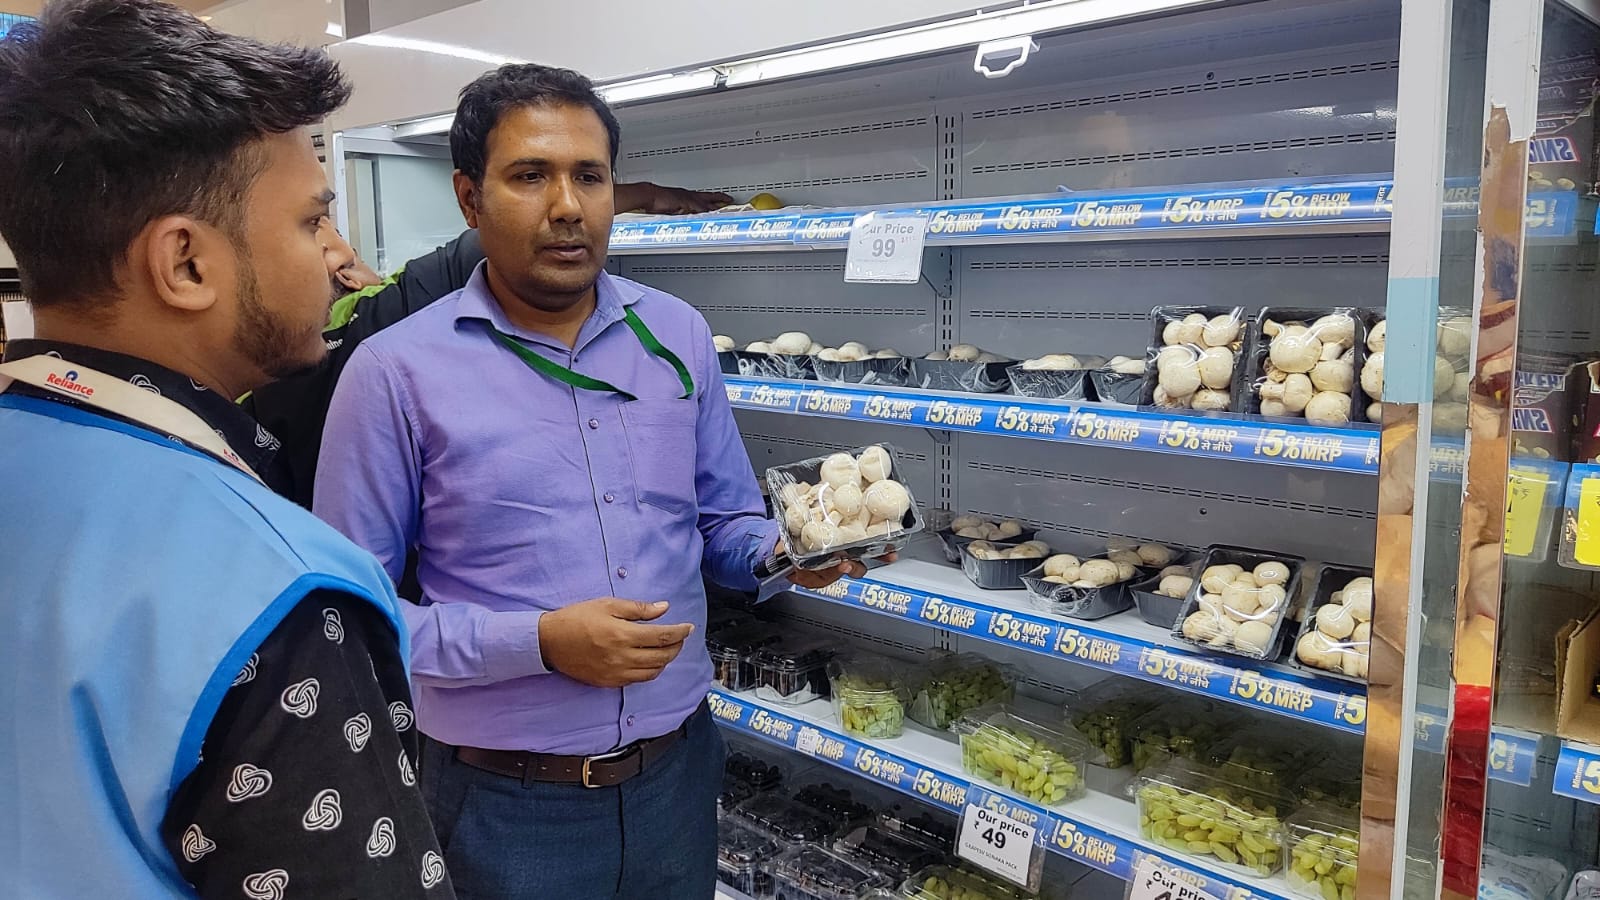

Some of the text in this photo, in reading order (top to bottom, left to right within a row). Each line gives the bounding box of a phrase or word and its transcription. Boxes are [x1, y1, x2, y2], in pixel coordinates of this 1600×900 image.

[1078, 201, 1111, 227] 5%
[1111, 203, 1143, 213] BELOW
[1169, 197, 1206, 223] 5%
[1205, 198, 1243, 210] MRP
[1268, 191, 1308, 218] 5%
[1311, 192, 1351, 202] BELOW
[1307, 201, 1350, 217] MRP
[806, 219, 827, 239] 5%
[885, 223, 914, 234] Price
[931, 209, 957, 233] 5%
[955, 221, 982, 233] MRP
[1004, 205, 1032, 230] 5%
[1032, 207, 1063, 218] MRP
[1107, 212, 1141, 226] MRP
[825, 228, 849, 238] MRP
[872, 238, 895, 257] 99
[47, 372, 94, 396] Reliance
[810, 390, 830, 412] 5%
[829, 402, 851, 414] MRP
[870, 395, 891, 418] 5%
[892, 401, 916, 412] MRP
[932, 401, 956, 425] 5%
[954, 414, 982, 427] MRP
[1002, 406, 1030, 432] 5%
[1031, 411, 1059, 424] MRP
[1077, 412, 1107, 440] 5%
[1106, 427, 1139, 442] MRP
[1166, 420, 1238, 450] 5% MRP
[1263, 428, 1301, 460] 5%
[1303, 436, 1342, 448] BELOW
[1300, 447, 1342, 462] MRP
[865, 584, 912, 609] 5% MRP
[925, 595, 951, 625] 5%
[952, 606, 977, 618] BELOW
[949, 612, 975, 629] MRP
[993, 612, 1023, 641] 5%
[1022, 622, 1051, 637] MRP
[1060, 628, 1121, 659] 5% BELOW
[1088, 647, 1120, 665] MRP
[1146, 648, 1214, 681] 5% MRP
[1178, 673, 1210, 689] से नीचे
[1237, 669, 1274, 705] 5%
[1274, 687, 1313, 712] MRP
[721, 707, 741, 722] MRP
[753, 709, 793, 735] 5% MRP
[822, 744, 844, 760] MRP
[859, 749, 904, 776] 5% MRP
[918, 770, 942, 800] 5%
[942, 782, 967, 797] BELOW
[939, 790, 966, 808] MRP
[978, 809, 1029, 838] Our price
[1011, 807, 1038, 825] MRP
[982, 827, 1006, 849] 49
[1058, 821, 1087, 856] 5%
[1087, 836, 1117, 853] BELOW
[1085, 845, 1116, 866] MRP
[1153, 870, 1176, 889] Our
